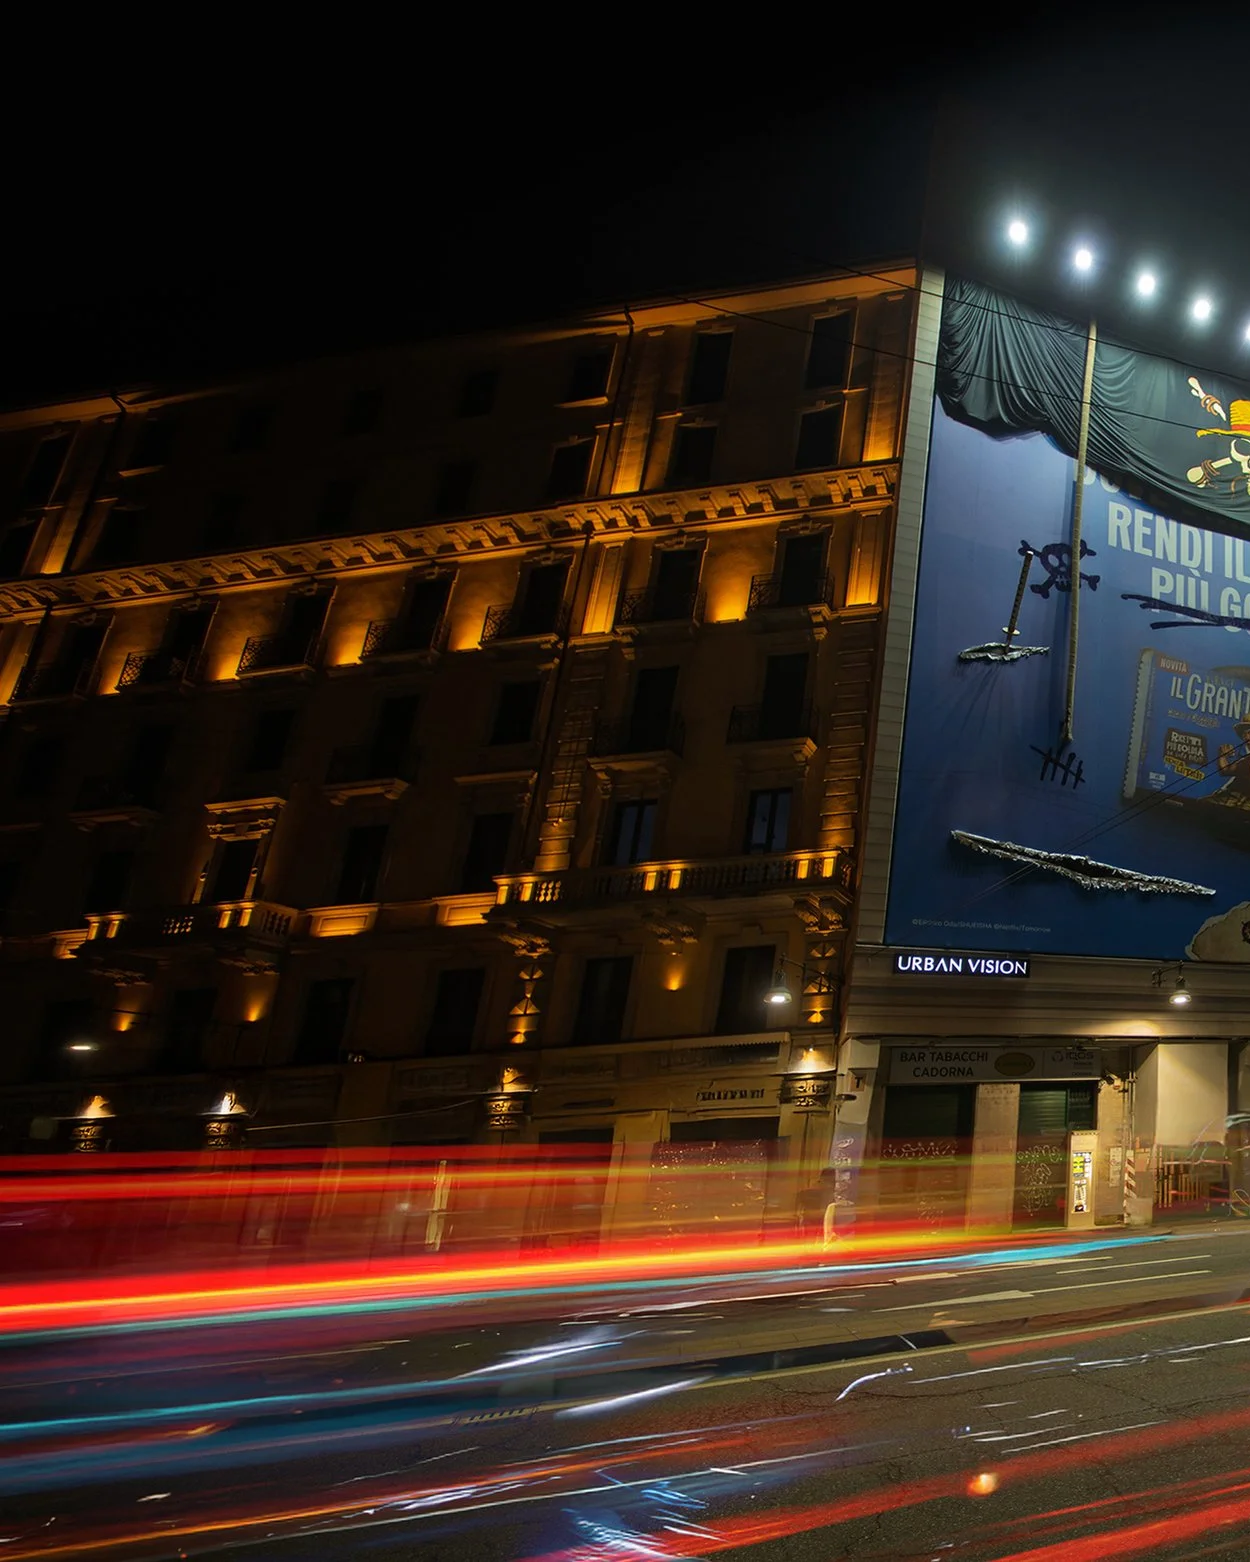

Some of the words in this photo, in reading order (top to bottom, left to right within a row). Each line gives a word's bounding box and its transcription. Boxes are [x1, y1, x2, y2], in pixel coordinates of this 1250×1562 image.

[1108, 501, 1211, 573] RENDI
[898, 955, 962, 973] URBAN
[968, 958, 1027, 975] VISION
[900, 1052, 925, 1062] BAR
[929, 1051, 988, 1062] TABACCHI
[912, 1067, 974, 1077] CADORNA
